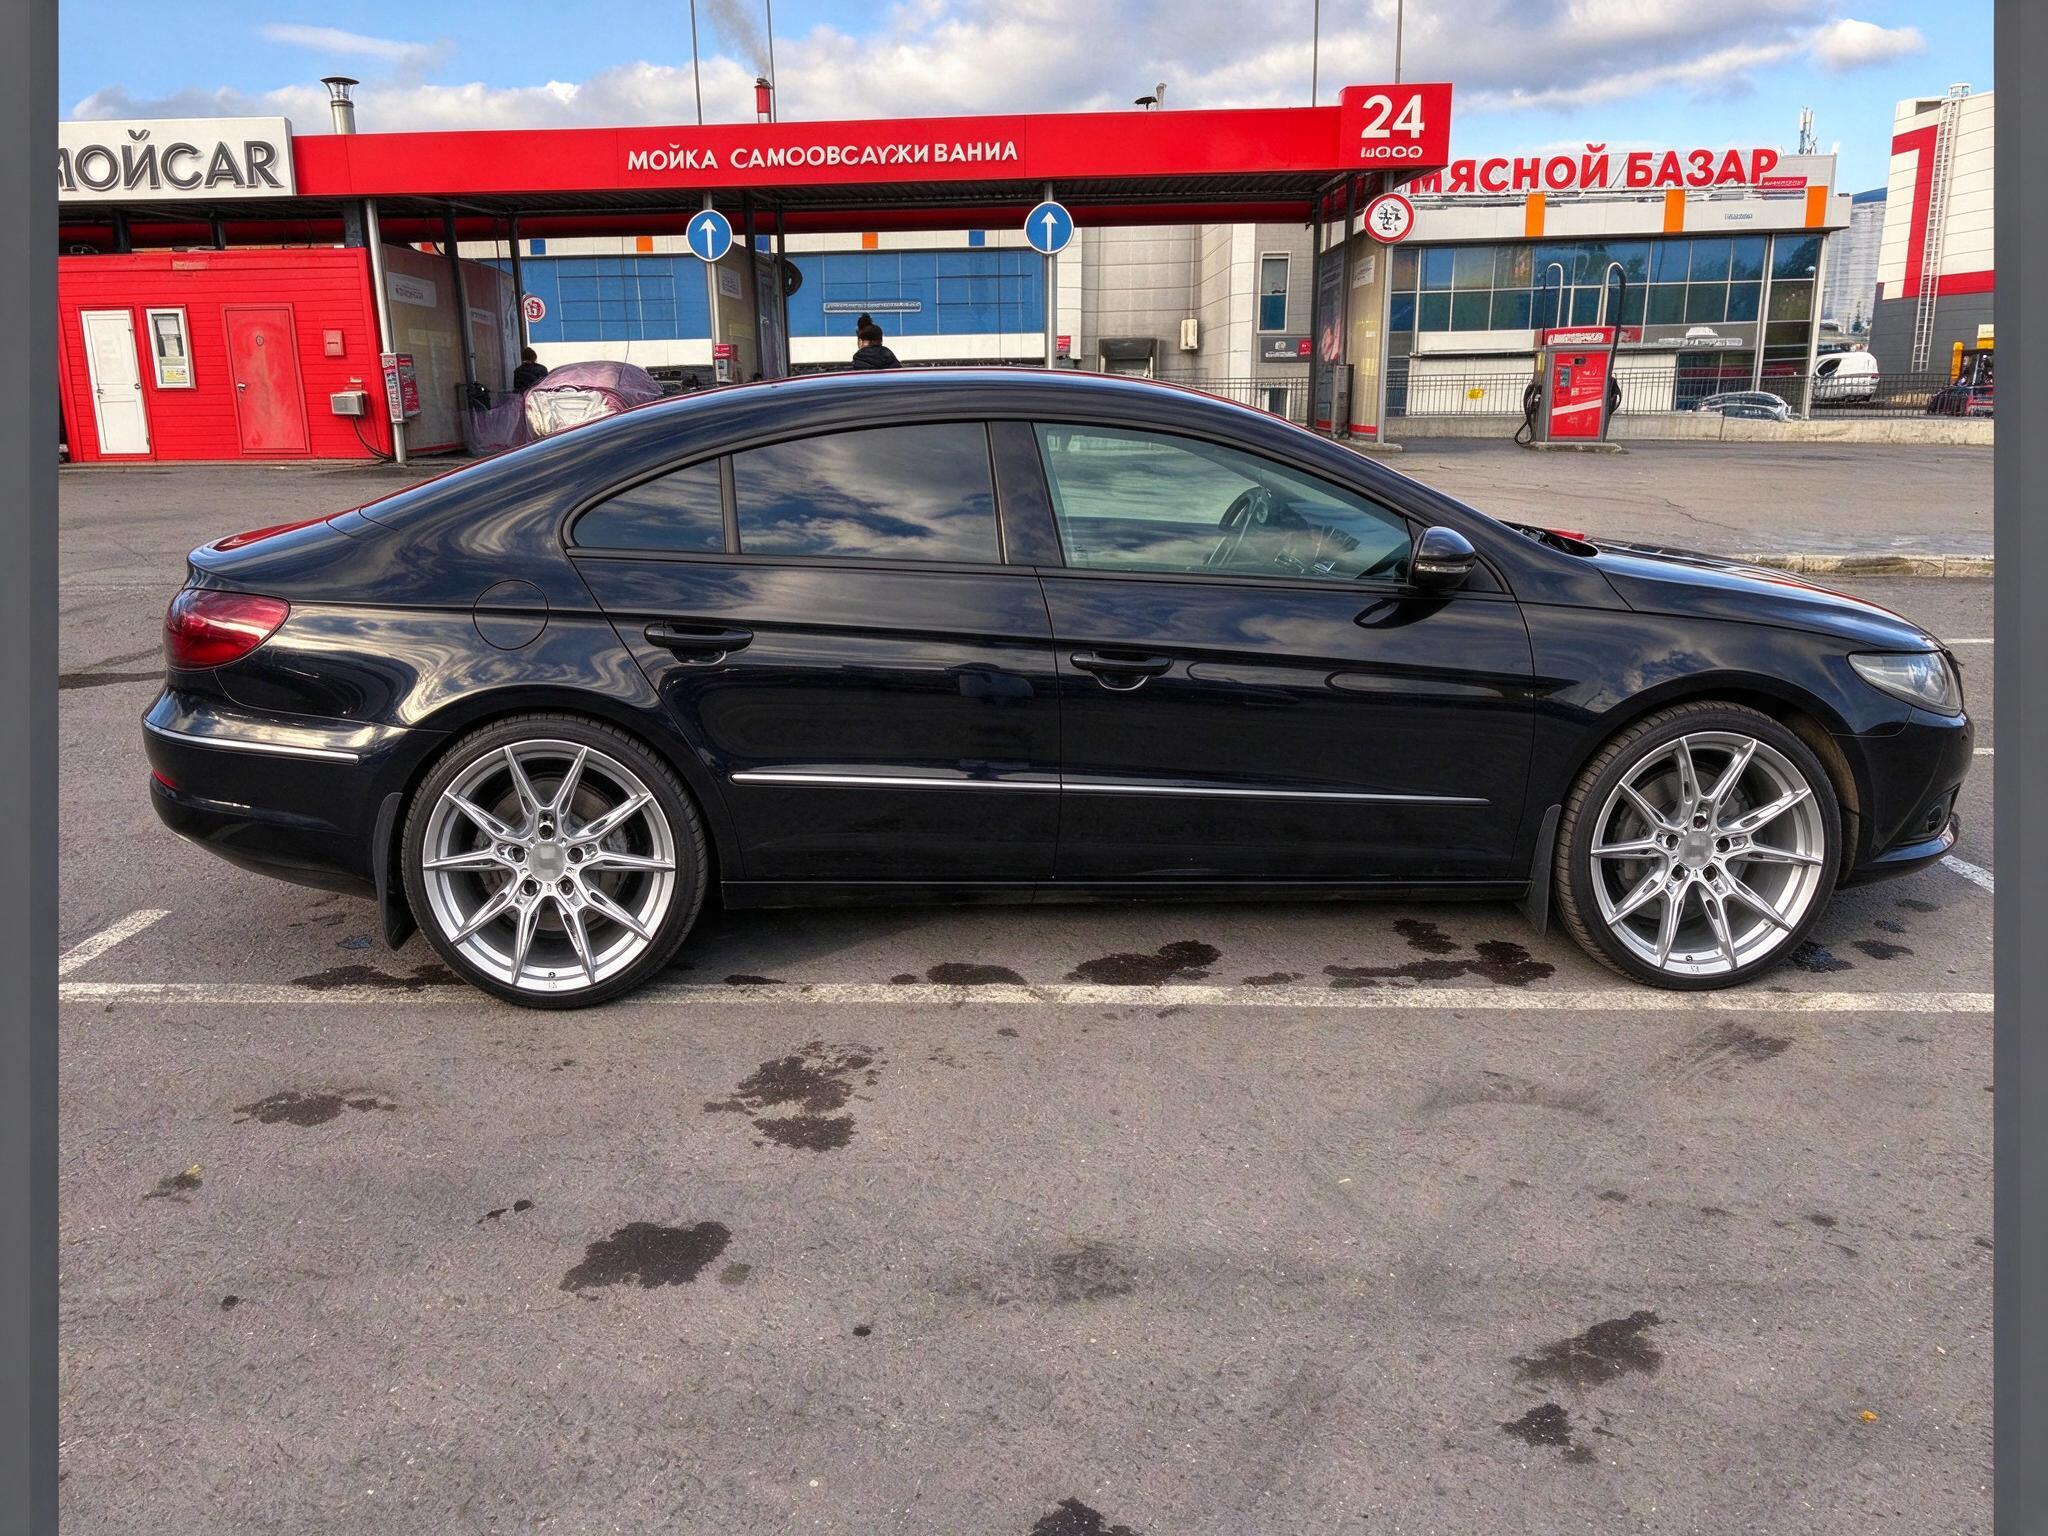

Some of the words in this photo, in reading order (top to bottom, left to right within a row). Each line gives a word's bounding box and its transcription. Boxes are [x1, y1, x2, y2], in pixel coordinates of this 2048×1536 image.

[1361, 94, 1425, 139] 24
[627, 142, 719, 171] МОЙКА
[1626, 148, 1778, 188] БАЗАР
